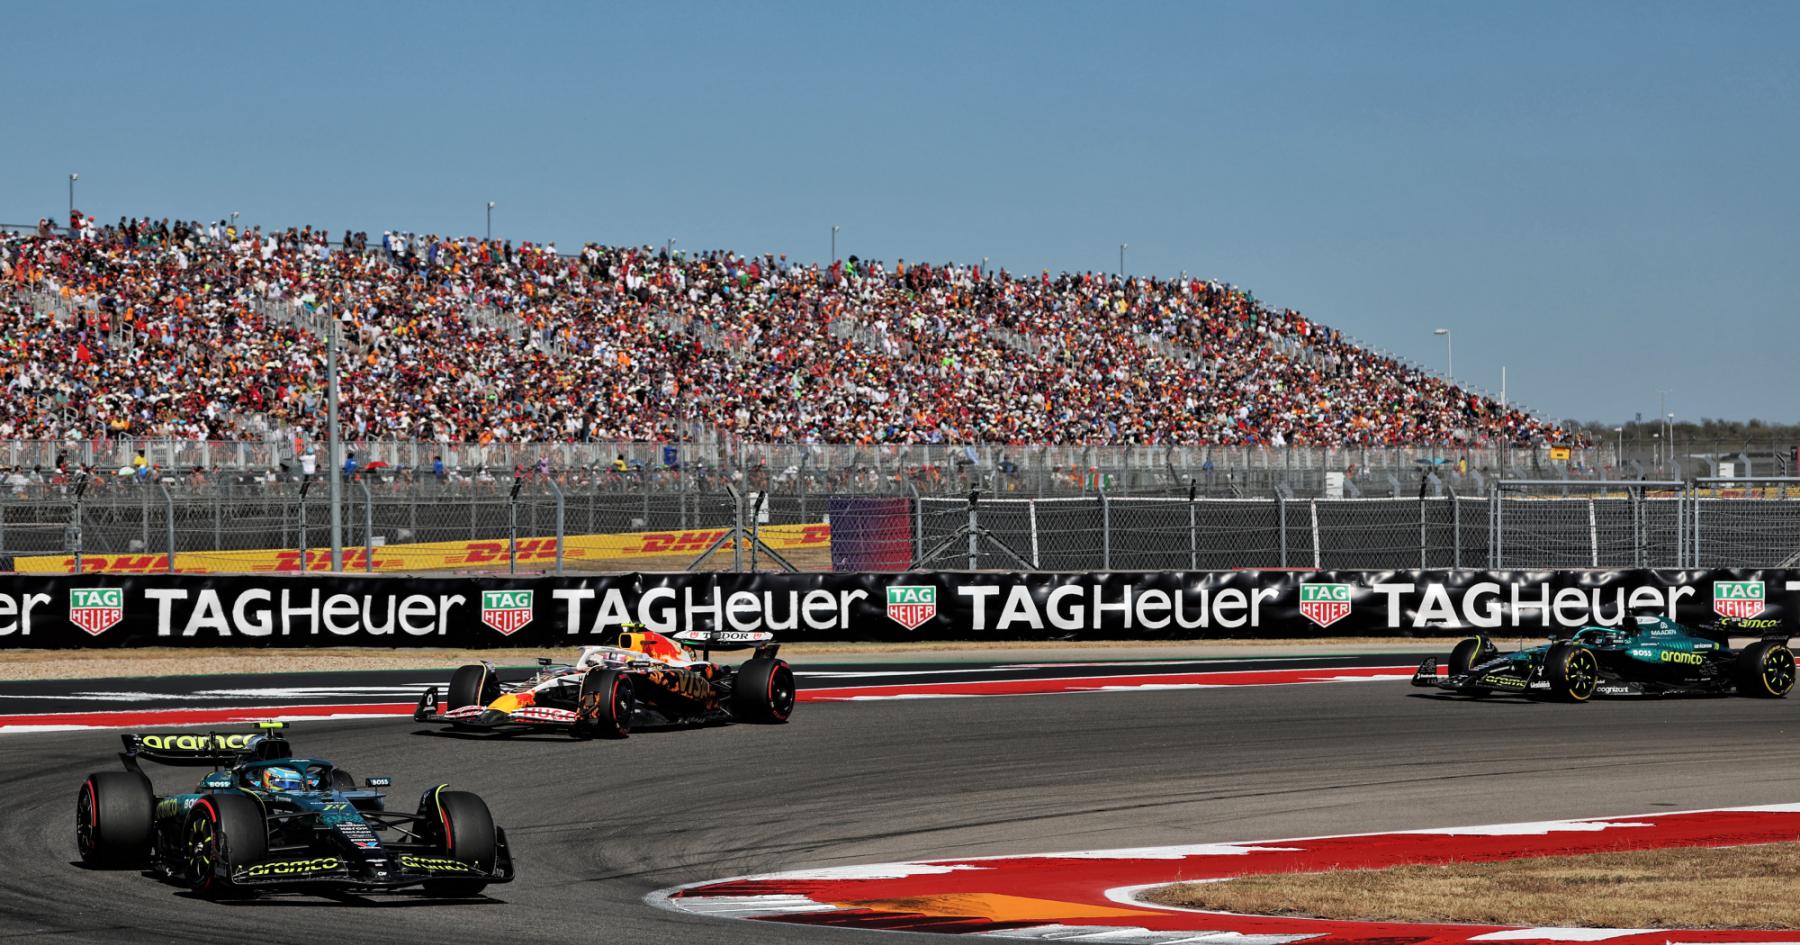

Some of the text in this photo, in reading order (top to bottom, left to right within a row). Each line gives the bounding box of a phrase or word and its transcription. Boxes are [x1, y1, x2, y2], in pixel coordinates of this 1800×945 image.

[641, 531, 735, 552] DHL
[464, 539, 562, 562] DHL
[274, 548, 383, 571] DHL
[74, 591, 118, 605] TAG
[890, 588, 933, 602] TAG
[1304, 586, 1347, 600] TAG
[1717, 584, 1760, 598] TAG
[487, 593, 529, 607] TAG
[72, 609, 120, 632] HEUER
[485, 610, 531, 633] HEUER
[889, 605, 934, 626] HEUER
[1302, 603, 1349, 624] HEUER
[1721, 618, 1777, 628] aamco
[1661, 650, 1703, 665] aramco
[1486, 675, 1527, 688] aramc
[249, 857, 338, 876] aramco
